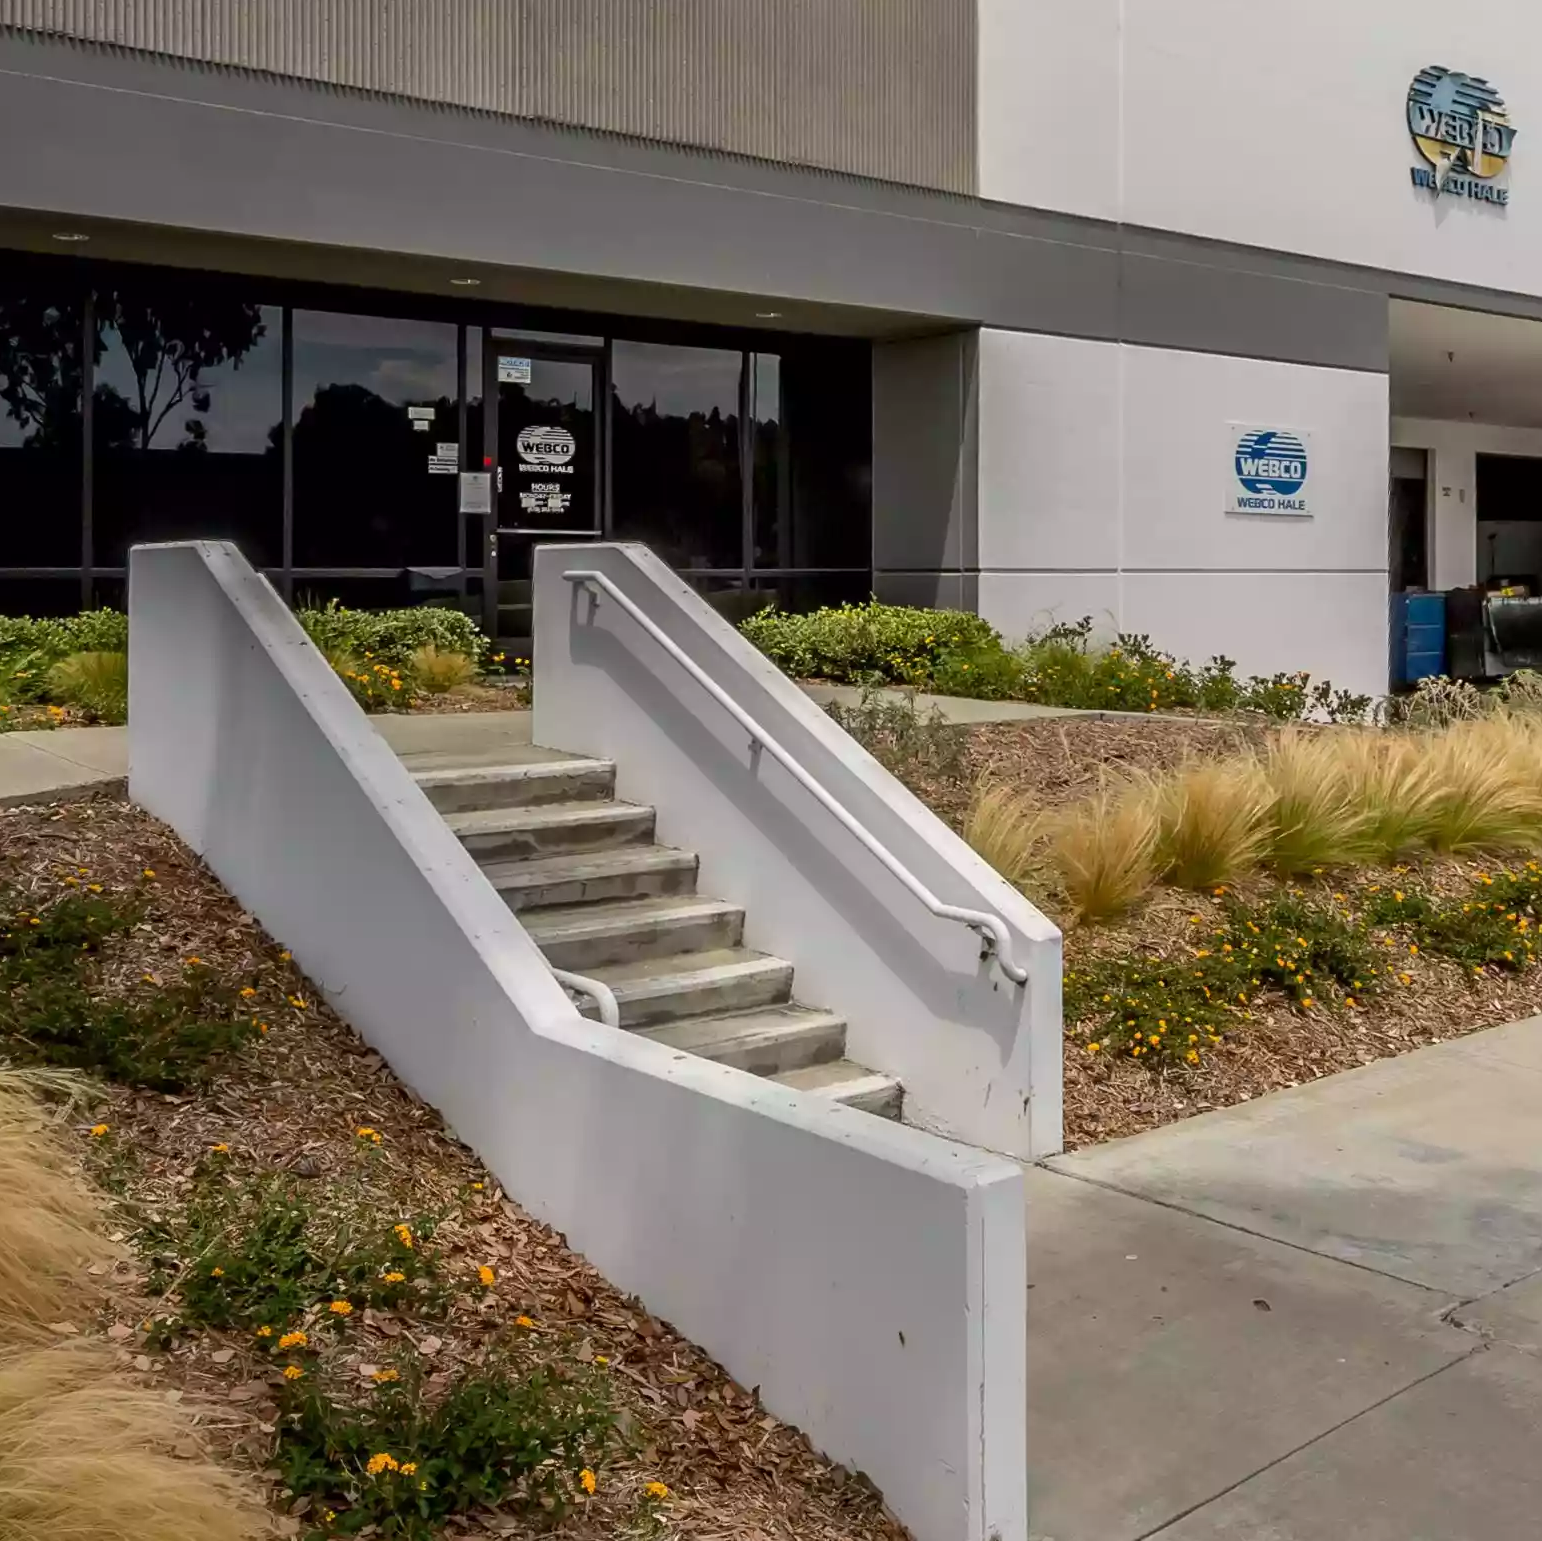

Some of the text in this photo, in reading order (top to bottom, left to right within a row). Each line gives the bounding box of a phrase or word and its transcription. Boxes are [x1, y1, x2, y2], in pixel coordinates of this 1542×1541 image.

[1417, 105, 1504, 154] WEBO
[1467, 179, 1509, 205] HALE
[522, 442, 569, 454] WEBCO
[1239, 458, 1302, 478] WEBCO
[531, 483, 560, 493] HOURS
[1236, 497, 1306, 511] WEBCO HALE
